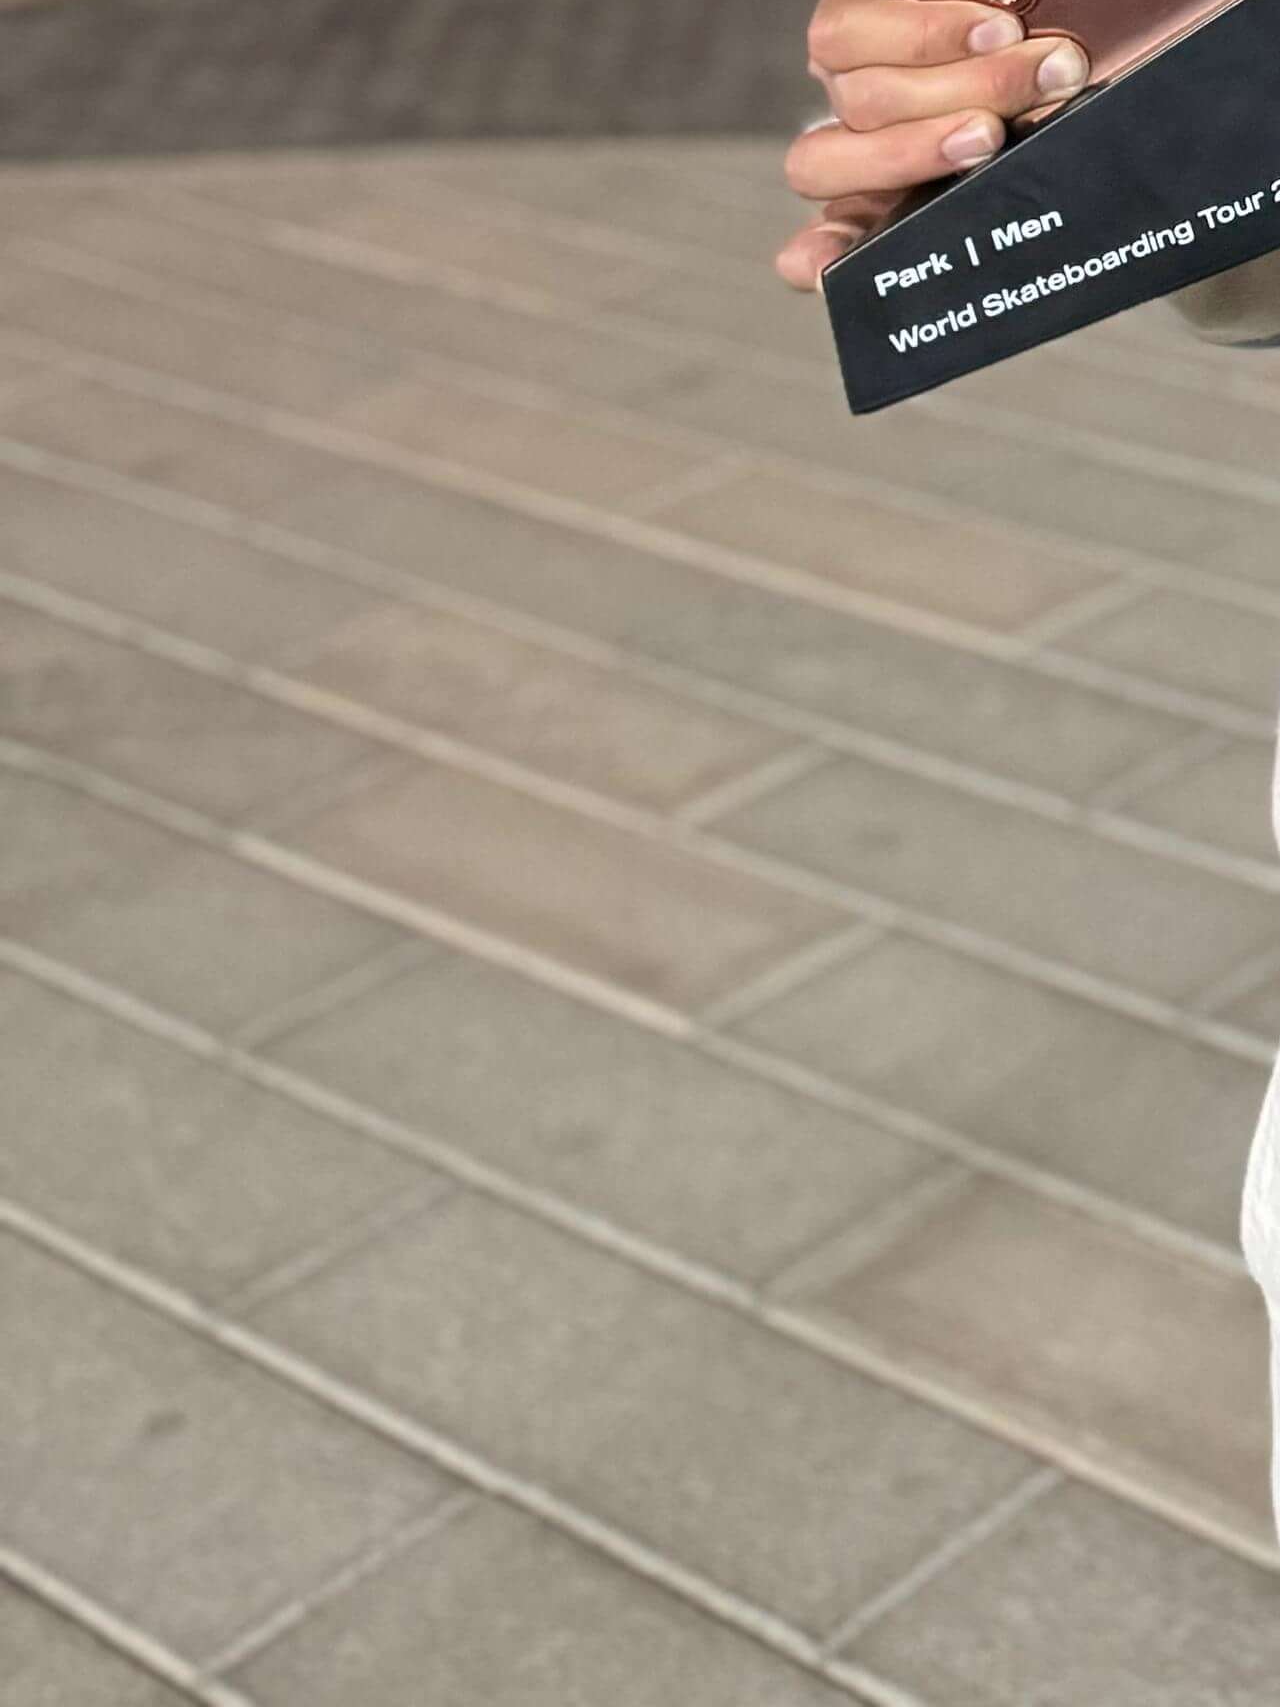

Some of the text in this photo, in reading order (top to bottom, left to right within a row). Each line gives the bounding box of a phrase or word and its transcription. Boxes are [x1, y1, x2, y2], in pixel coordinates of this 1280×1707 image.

[874, 253, 953, 297] Park
[991, 210, 1063, 251] Men
[888, 303, 978, 353] World
[982, 220, 1195, 317] Skateboarding
[1197, 191, 1265, 229] Tour
